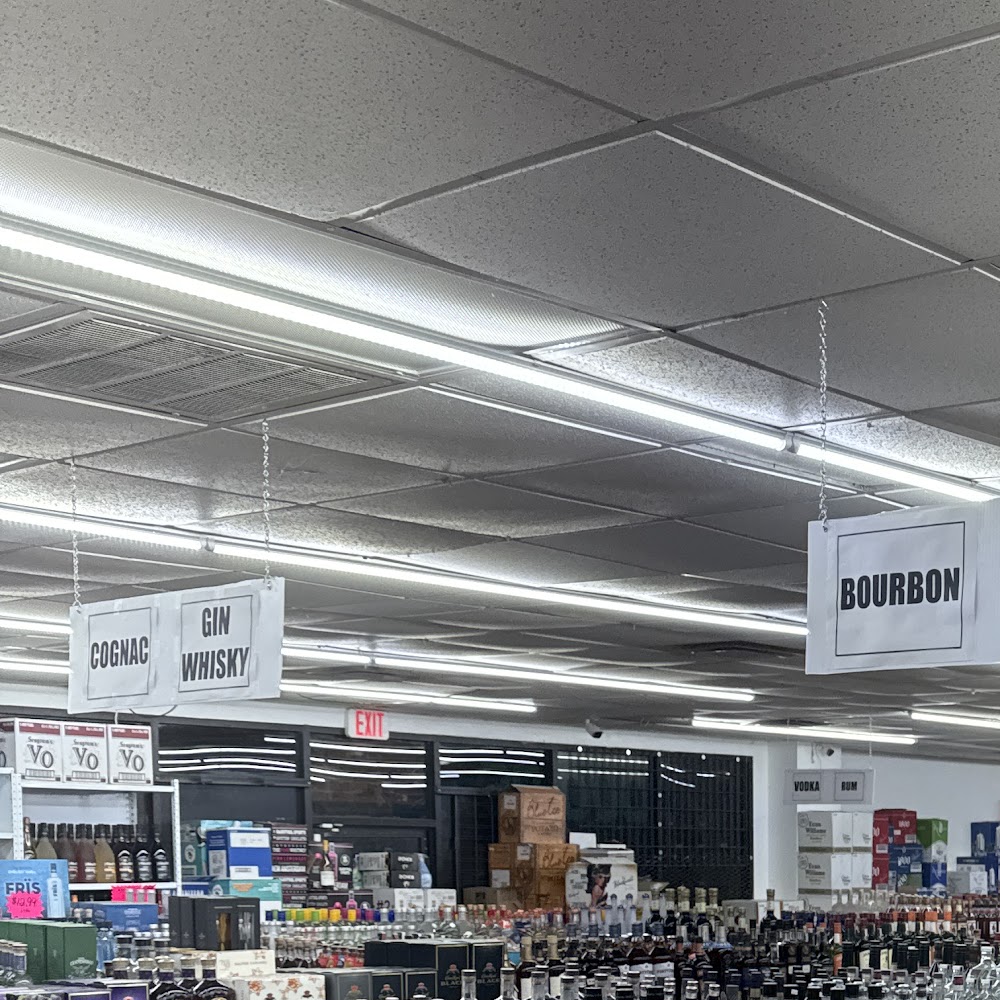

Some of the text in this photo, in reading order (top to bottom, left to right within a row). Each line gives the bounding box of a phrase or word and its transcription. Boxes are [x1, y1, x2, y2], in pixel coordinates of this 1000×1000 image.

[840, 568, 960, 610] BOURBON
[201, 605, 231, 637] GIN
[90, 636, 149, 669] COGNAC
[182, 647, 249, 682] WHISKY
[355, 709, 384, 738] EXIT
[794, 781, 820, 793] VODKA
[841, 781, 858, 792] RUM
